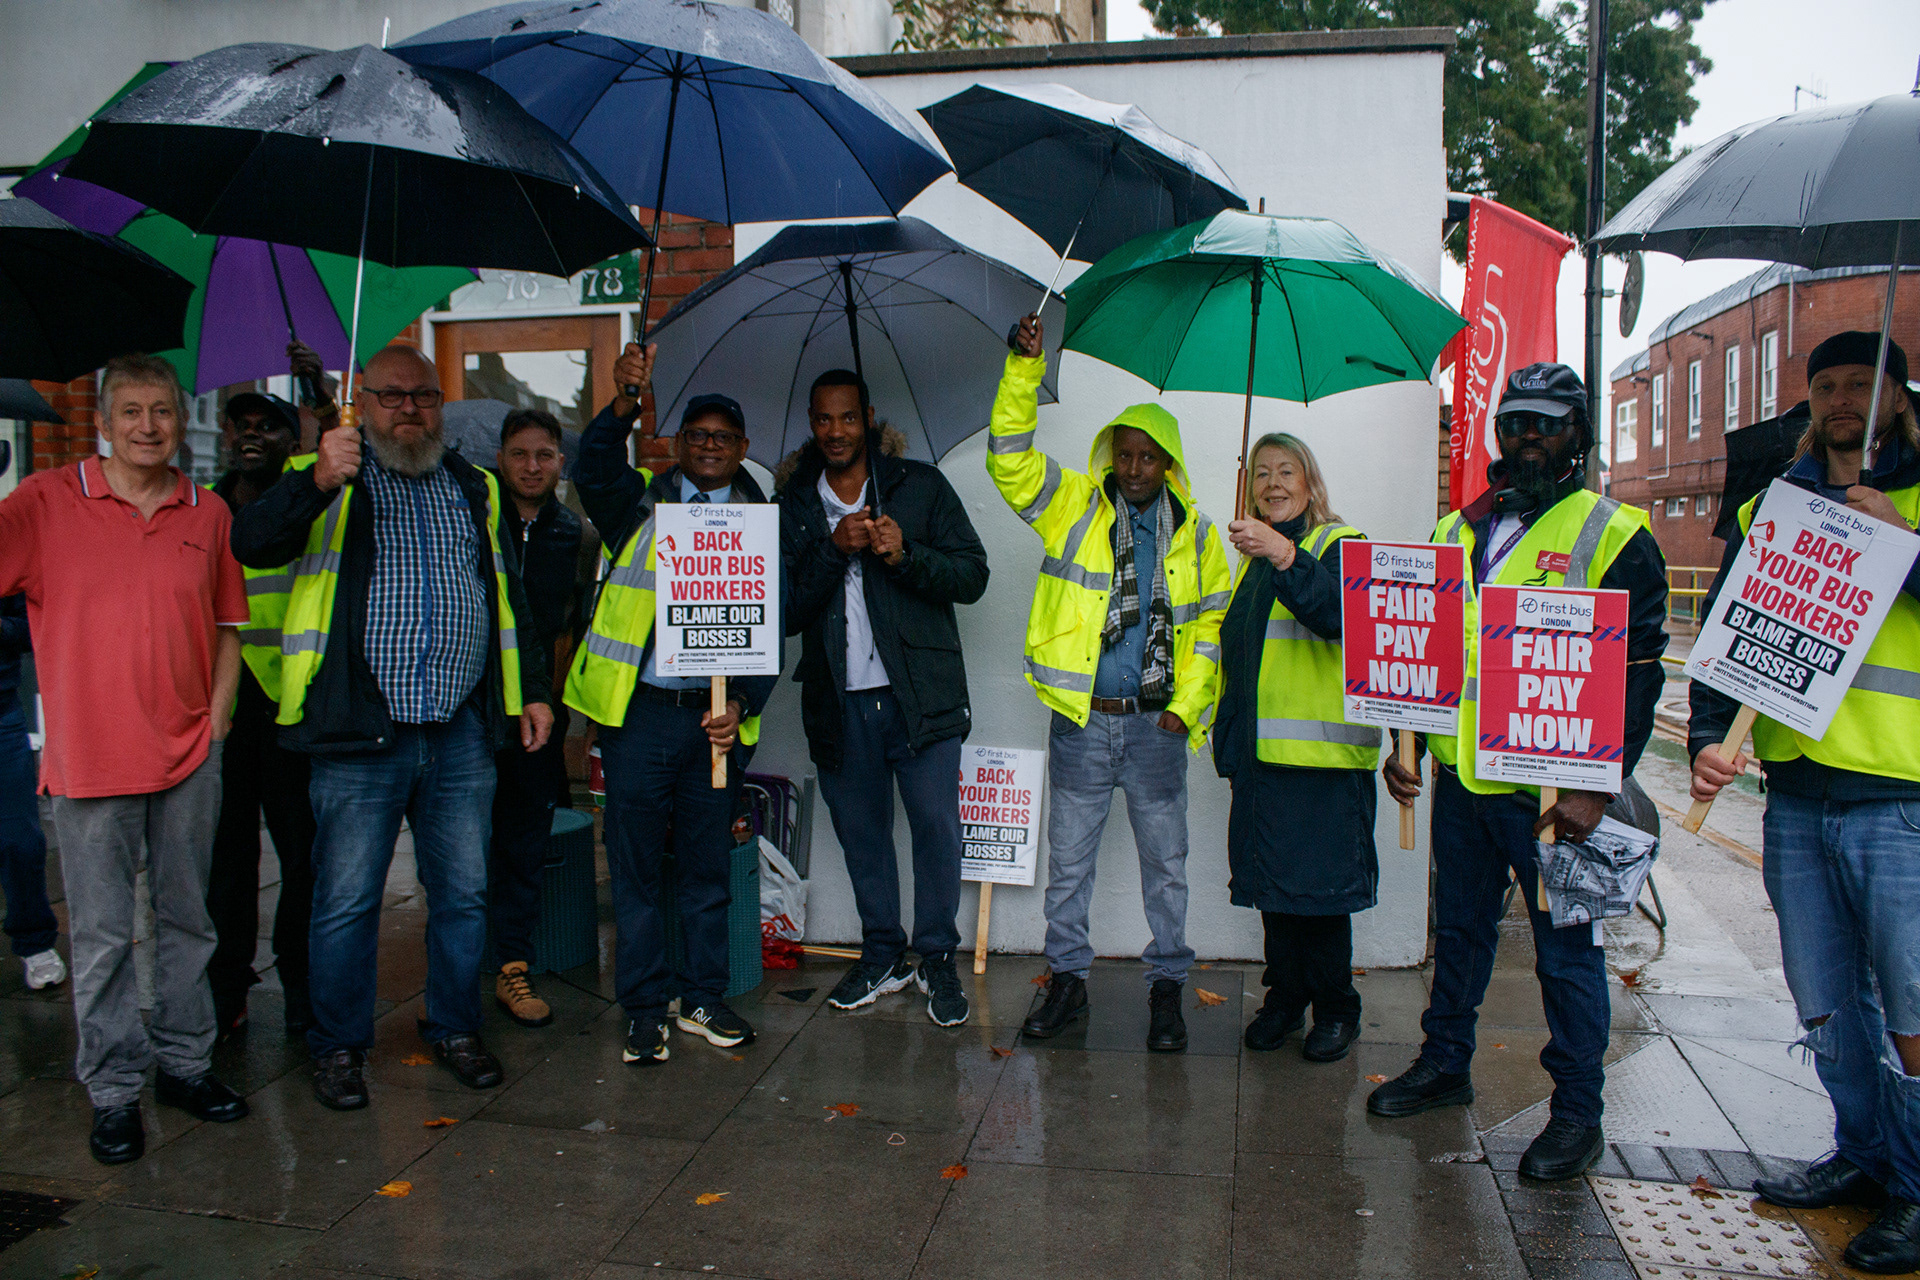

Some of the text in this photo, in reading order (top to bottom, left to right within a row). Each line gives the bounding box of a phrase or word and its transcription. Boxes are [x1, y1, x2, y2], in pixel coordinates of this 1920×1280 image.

[581, 268, 623, 296] 78
[705, 507, 742, 517] first bus
[1826, 507, 1874, 536] first bus
[1820, 521, 1849, 540] LONDON
[694, 532, 743, 551] BACK
[1792, 529, 1862, 576] BACK
[671, 556, 765, 576] YOUR BUS
[1391, 556, 1434, 570] first bus
[1392, 571, 1417, 579] LONDON
[1757, 547, 1874, 616] YOUR BUS
[671, 580, 766, 600] WORKERS
[1369, 585, 1436, 622] FAIR
[1541, 602, 1592, 617] first bus
[1741, 575, 1859, 646] WORKERS
[672, 606, 761, 624] BLAME OUR
[1541, 618, 1571, 627] LONDON
[687, 629, 746, 647] BOSSES
[1375, 623, 1430, 659] PAY
[1729, 605, 1839, 677] BLAME OUR
[1512, 634, 1593, 672] FAIR
[1733, 640, 1807, 689] BOSSES
[1369, 659, 1438, 698] NOW
[1717, 659, 1730, 669] UNITE
[1750, 676, 1760, 684] FOR
[1771, 686, 1781, 694] PAY
[1780, 691, 1790, 699] AND
[1790, 695, 1819, 712] CONDITIONS
[1518, 674, 1585, 712] PAY
[1508, 712, 1593, 752] NOW
[976, 767, 1016, 785] BACK
[1502, 762, 1547, 770] UNITETHEUNION.ORG
[959, 785, 1031, 805] YOUR BUS
[960, 804, 1030, 825] WORKERS
[963, 826, 1025, 843] LAME OUR
[965, 844, 1012, 859] BOSSES
